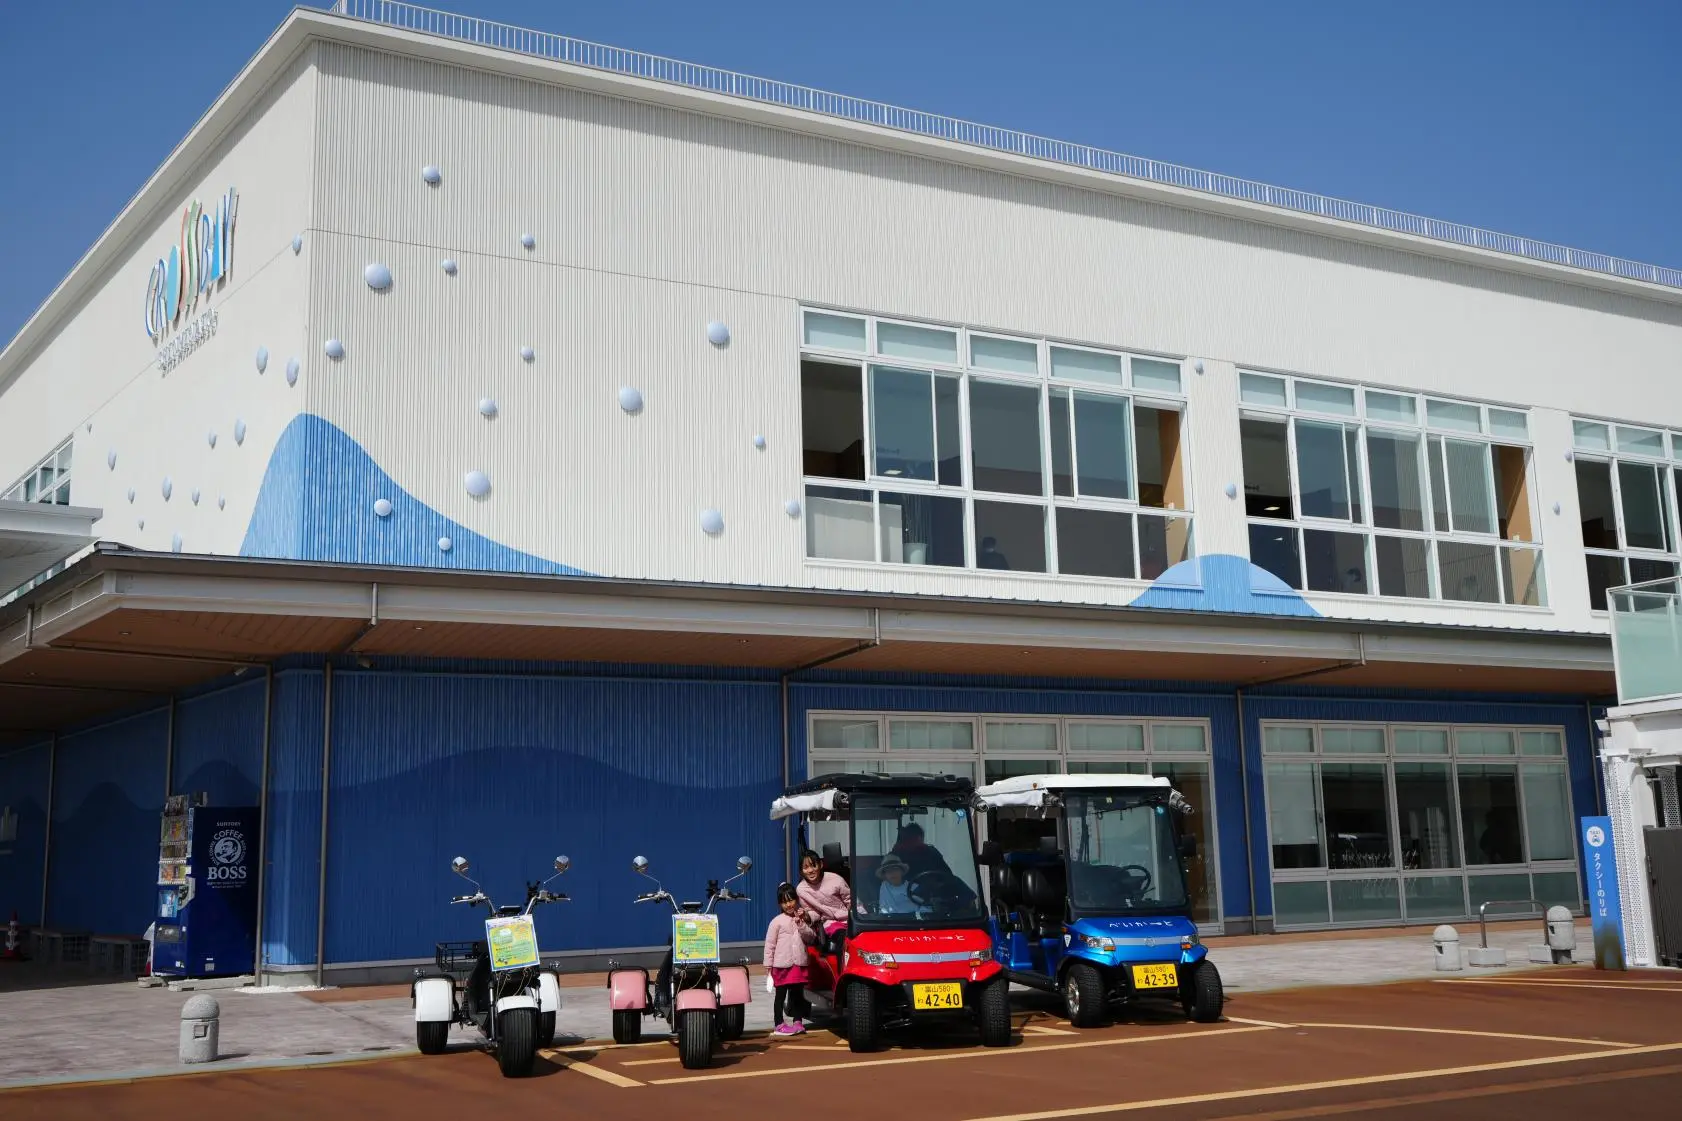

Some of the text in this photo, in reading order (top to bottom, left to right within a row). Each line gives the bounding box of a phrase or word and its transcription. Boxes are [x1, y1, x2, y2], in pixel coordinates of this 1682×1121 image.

[213, 829, 244, 840] COFFEE
[207, 866, 247, 880] BOSS
[1593, 852, 1607, 917] タクシーのりば
[1144, 973, 1175, 987] 42-39
[925, 993, 960, 1006] 42-40
